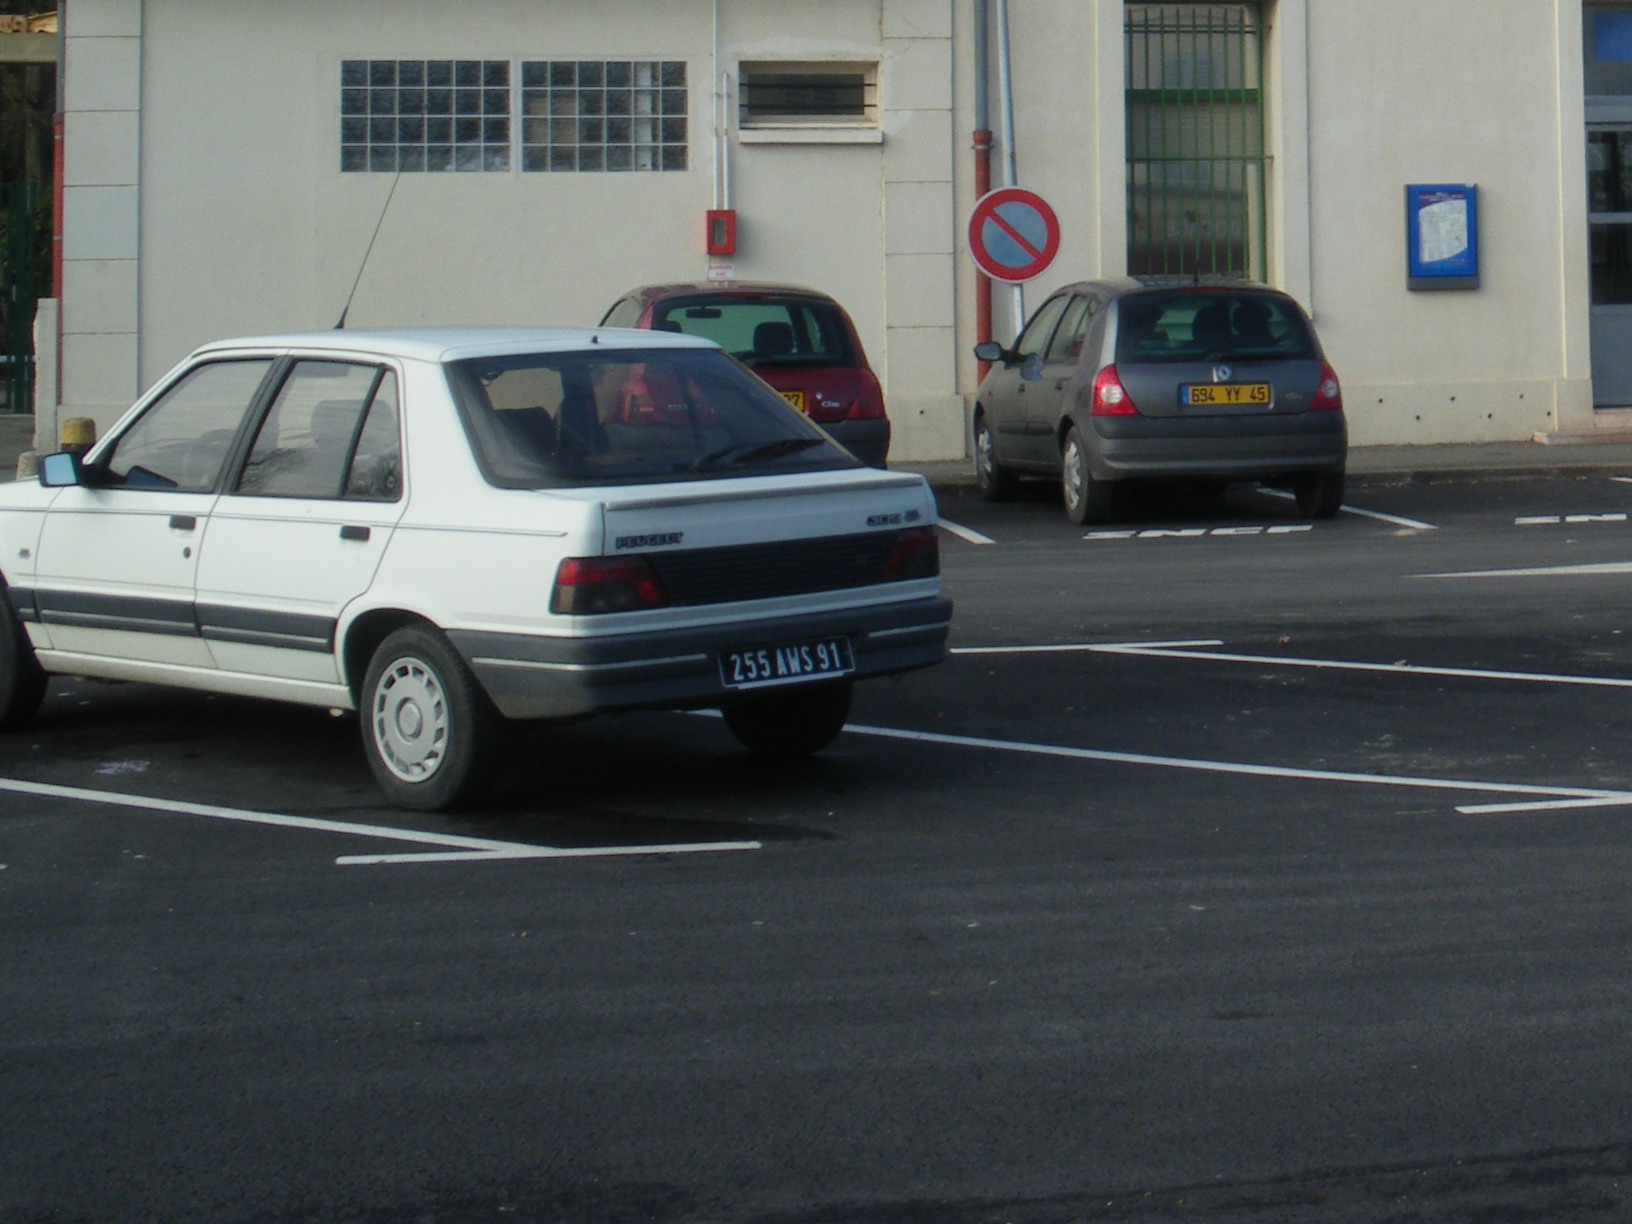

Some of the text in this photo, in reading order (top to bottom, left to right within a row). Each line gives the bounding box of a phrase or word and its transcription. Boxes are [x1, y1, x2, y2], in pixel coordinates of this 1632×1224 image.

[1225, 387, 1241, 401] YY
[1249, 386, 1266, 401] 45
[615, 532, 684, 550] PEUGEOT
[730, 642, 840, 681] 255 AWS 91
